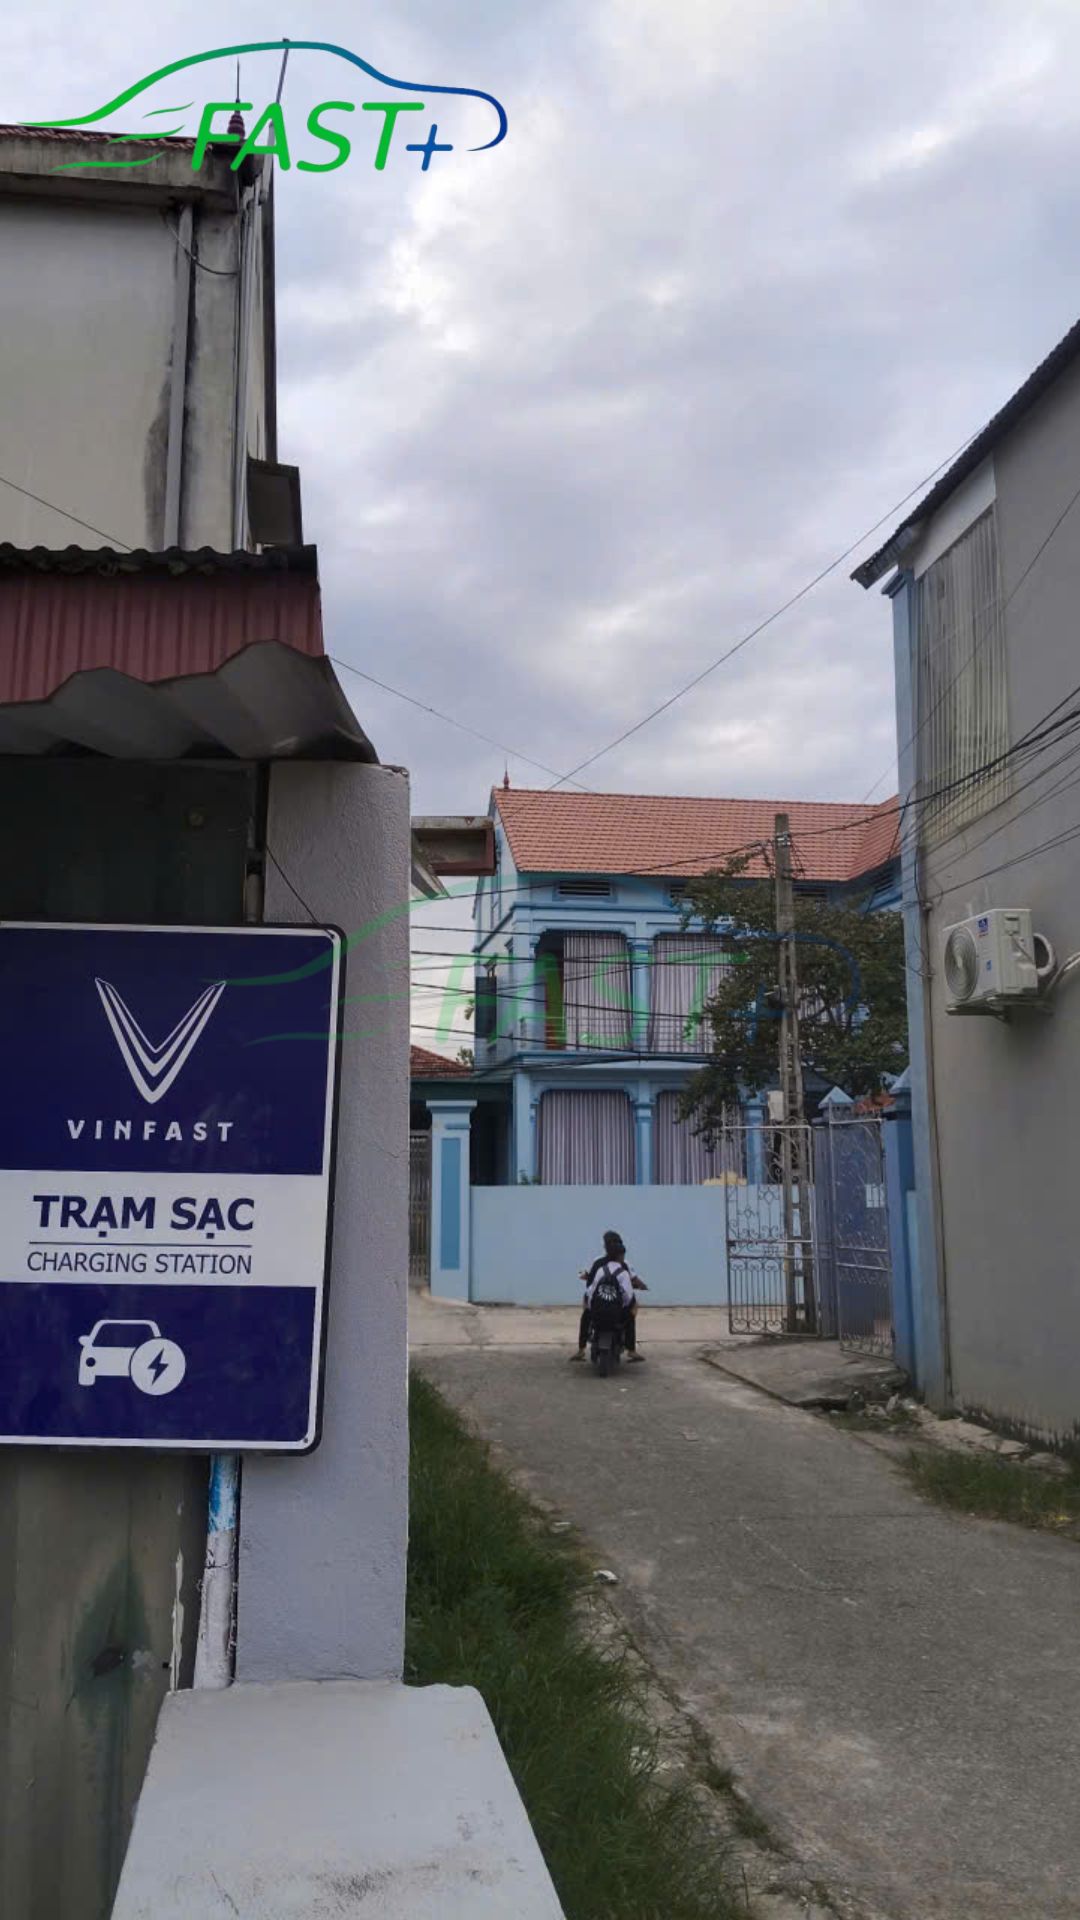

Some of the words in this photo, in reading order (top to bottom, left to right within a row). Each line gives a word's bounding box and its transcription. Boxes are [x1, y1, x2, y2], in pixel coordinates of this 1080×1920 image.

[67, 1119, 233, 1142] VINFAST
[33, 1194, 156, 1238] TRẠM
[170, 1197, 255, 1240] SẠC
[26, 1251, 148, 1274] CHARGING
[155, 1254, 253, 1275] STATION
